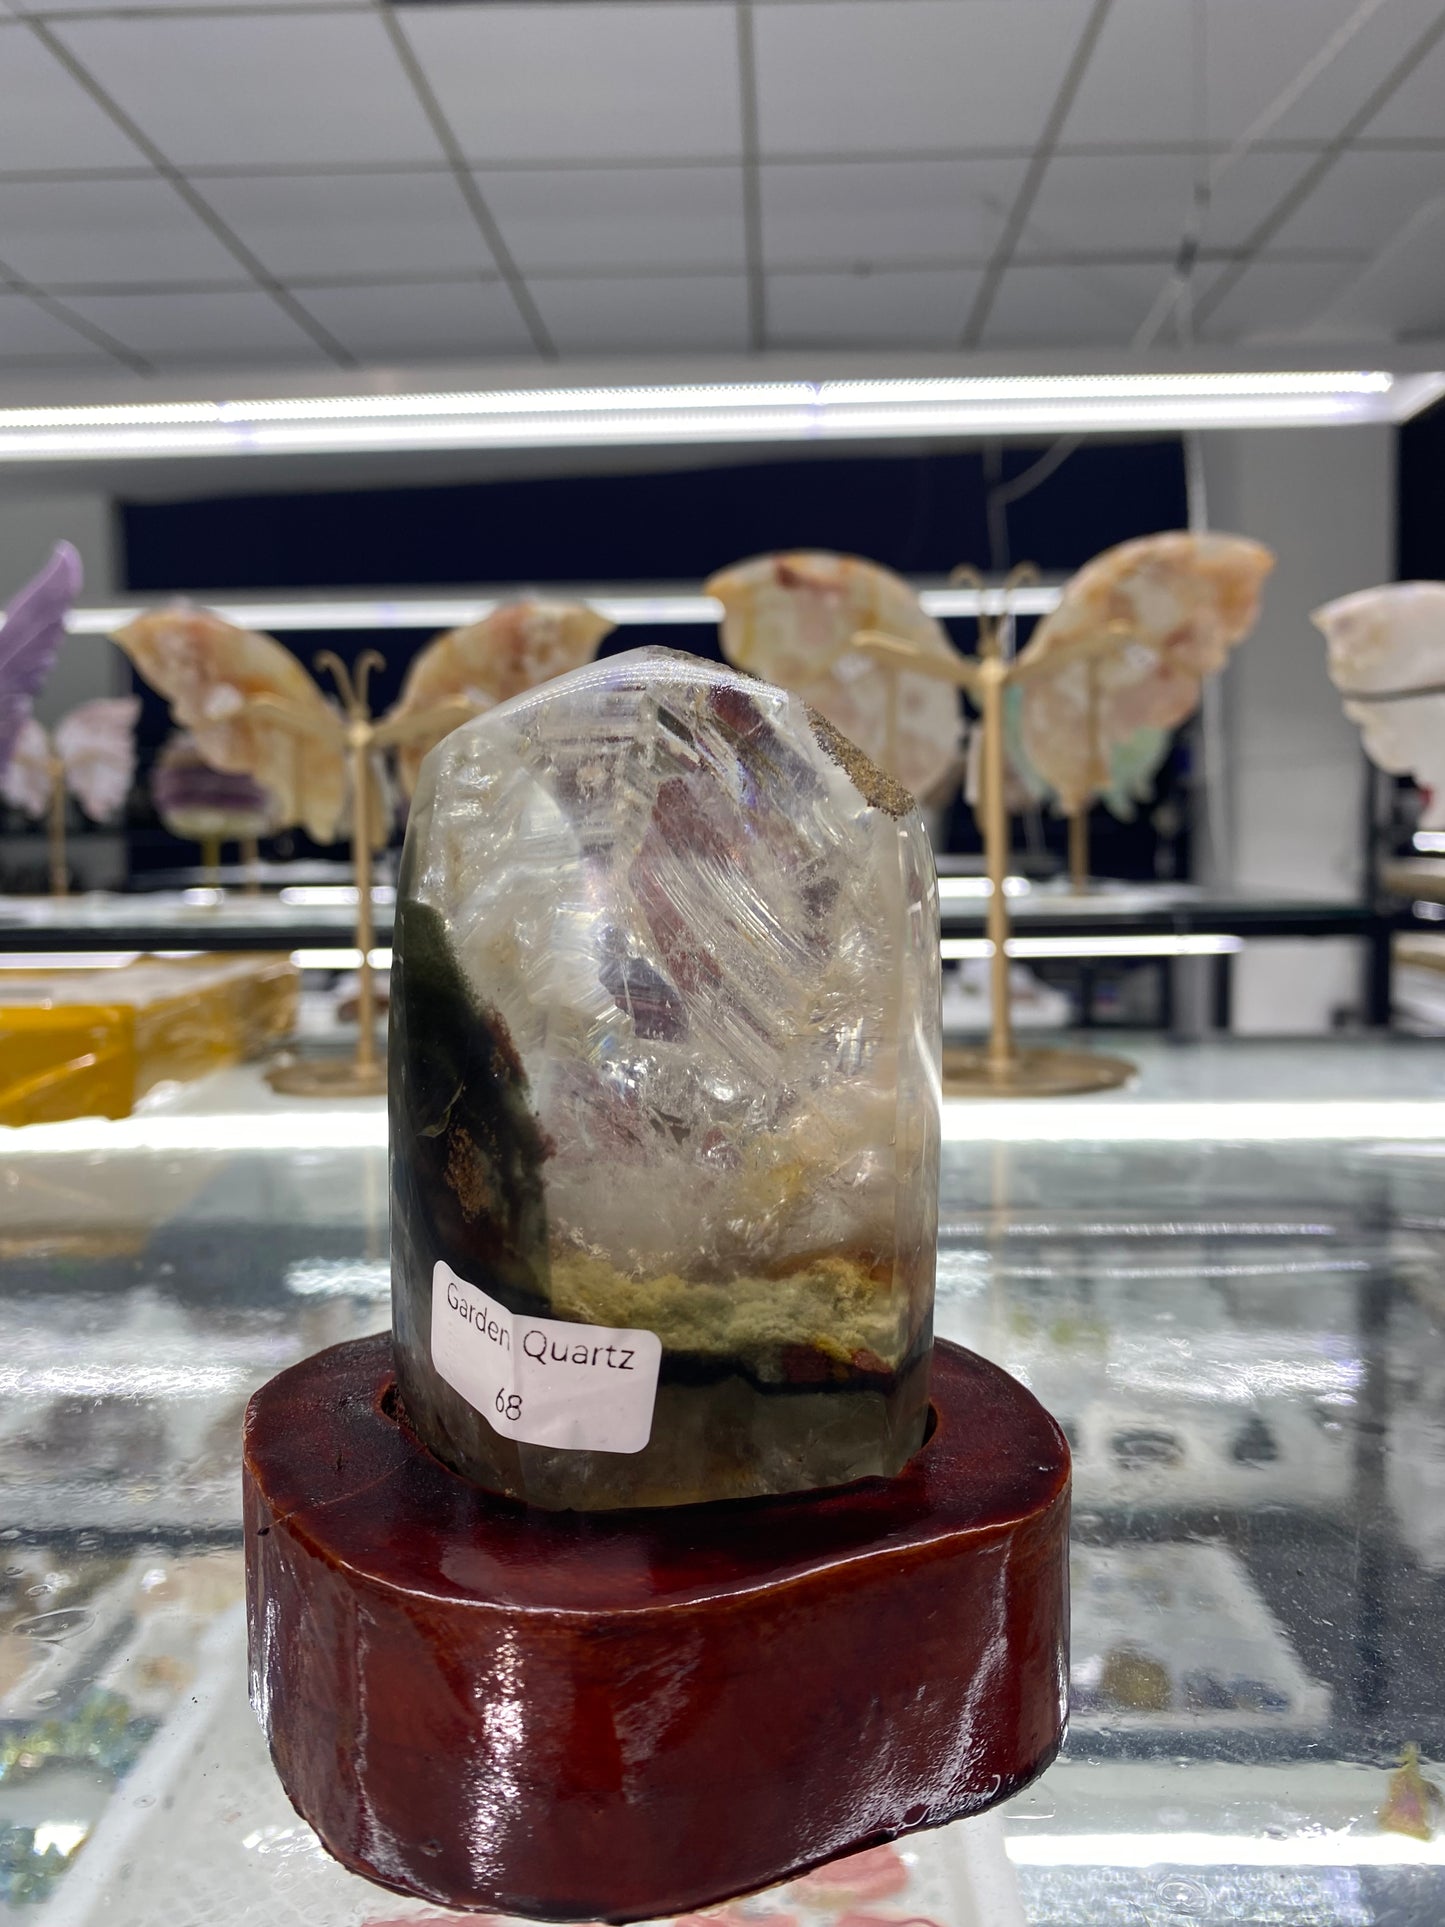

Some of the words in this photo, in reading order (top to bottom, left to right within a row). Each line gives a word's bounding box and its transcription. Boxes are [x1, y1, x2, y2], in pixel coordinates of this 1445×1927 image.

[447, 1283, 510, 1350] Garden
[523, 1330, 635, 1370] Quartz
[495, 1387, 523, 1421] 68
